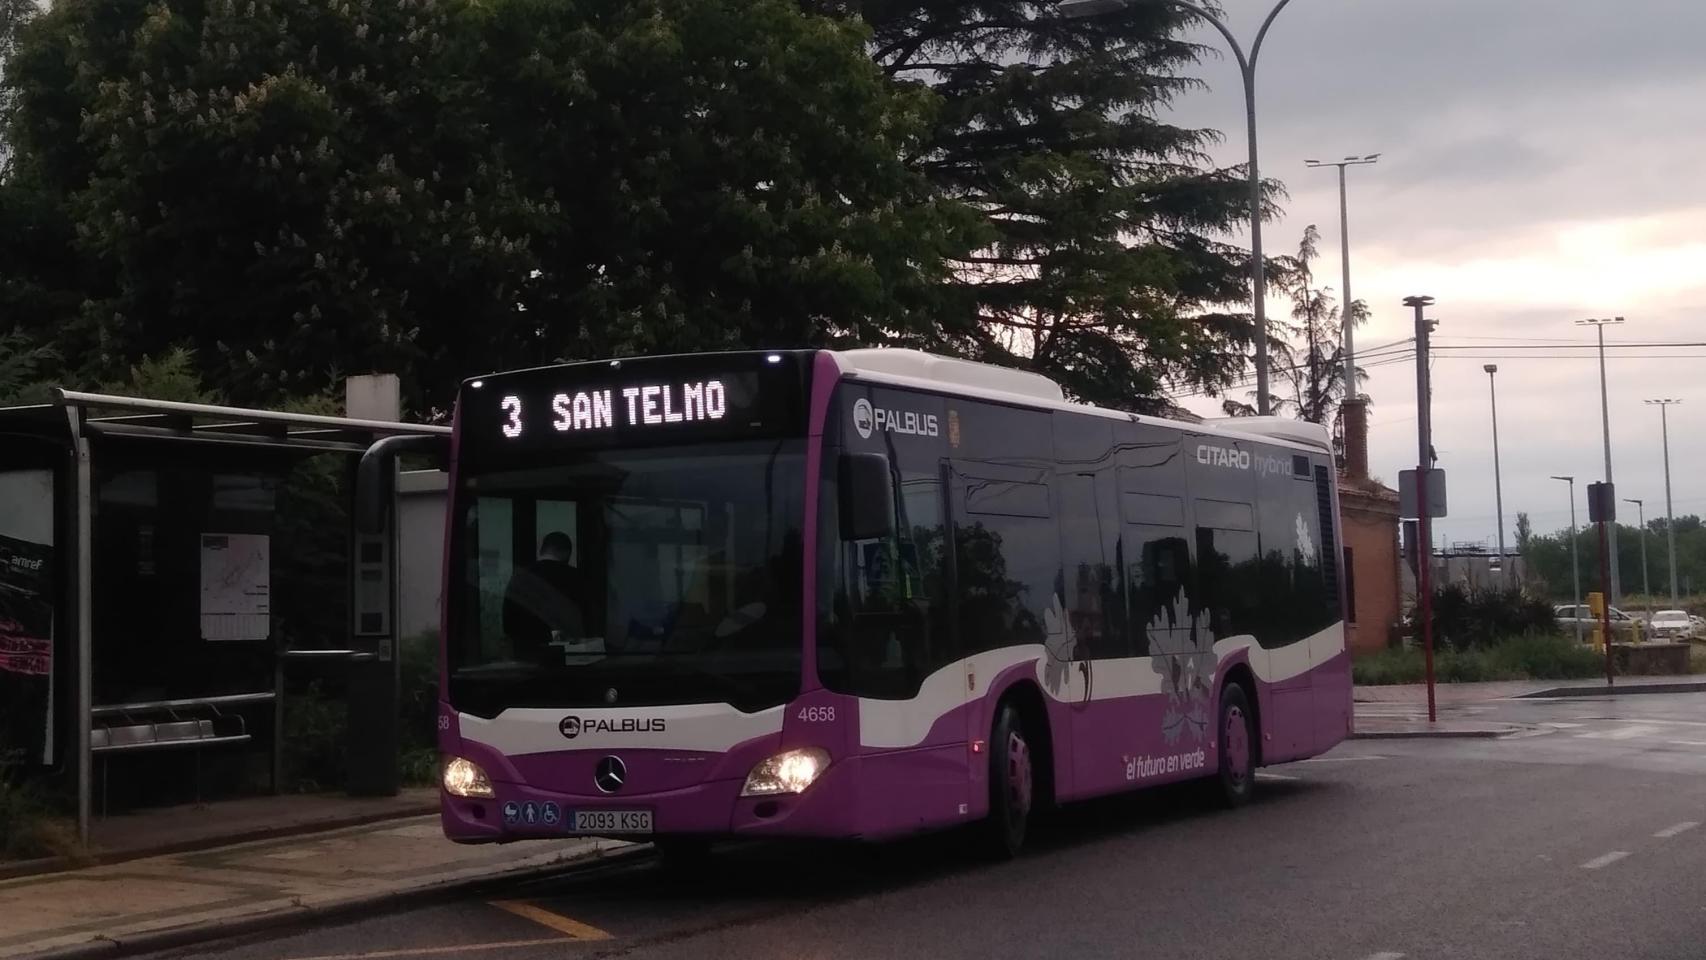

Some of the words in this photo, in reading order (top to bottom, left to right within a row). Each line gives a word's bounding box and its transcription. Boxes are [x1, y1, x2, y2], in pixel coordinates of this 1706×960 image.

[501, 396, 522, 437] 3
[552, 390, 613, 431] SAN
[622, 381, 726, 425] TELMO
[874, 408, 938, 436] PALBUS
[1196, 444, 1250, 470] CITARO
[1253, 449, 1293, 477] hybrid
[583, 719, 666, 733] PALBUS
[798, 706, 836, 721] 4658
[1126, 757, 1136, 780] el
[1136, 754, 1166, 779] futuro
[1167, 755, 1179, 773] en
[1180, 746, 1205, 771] verde
[579, 812, 615, 829] 2093
[620, 812, 649, 829] KSG
